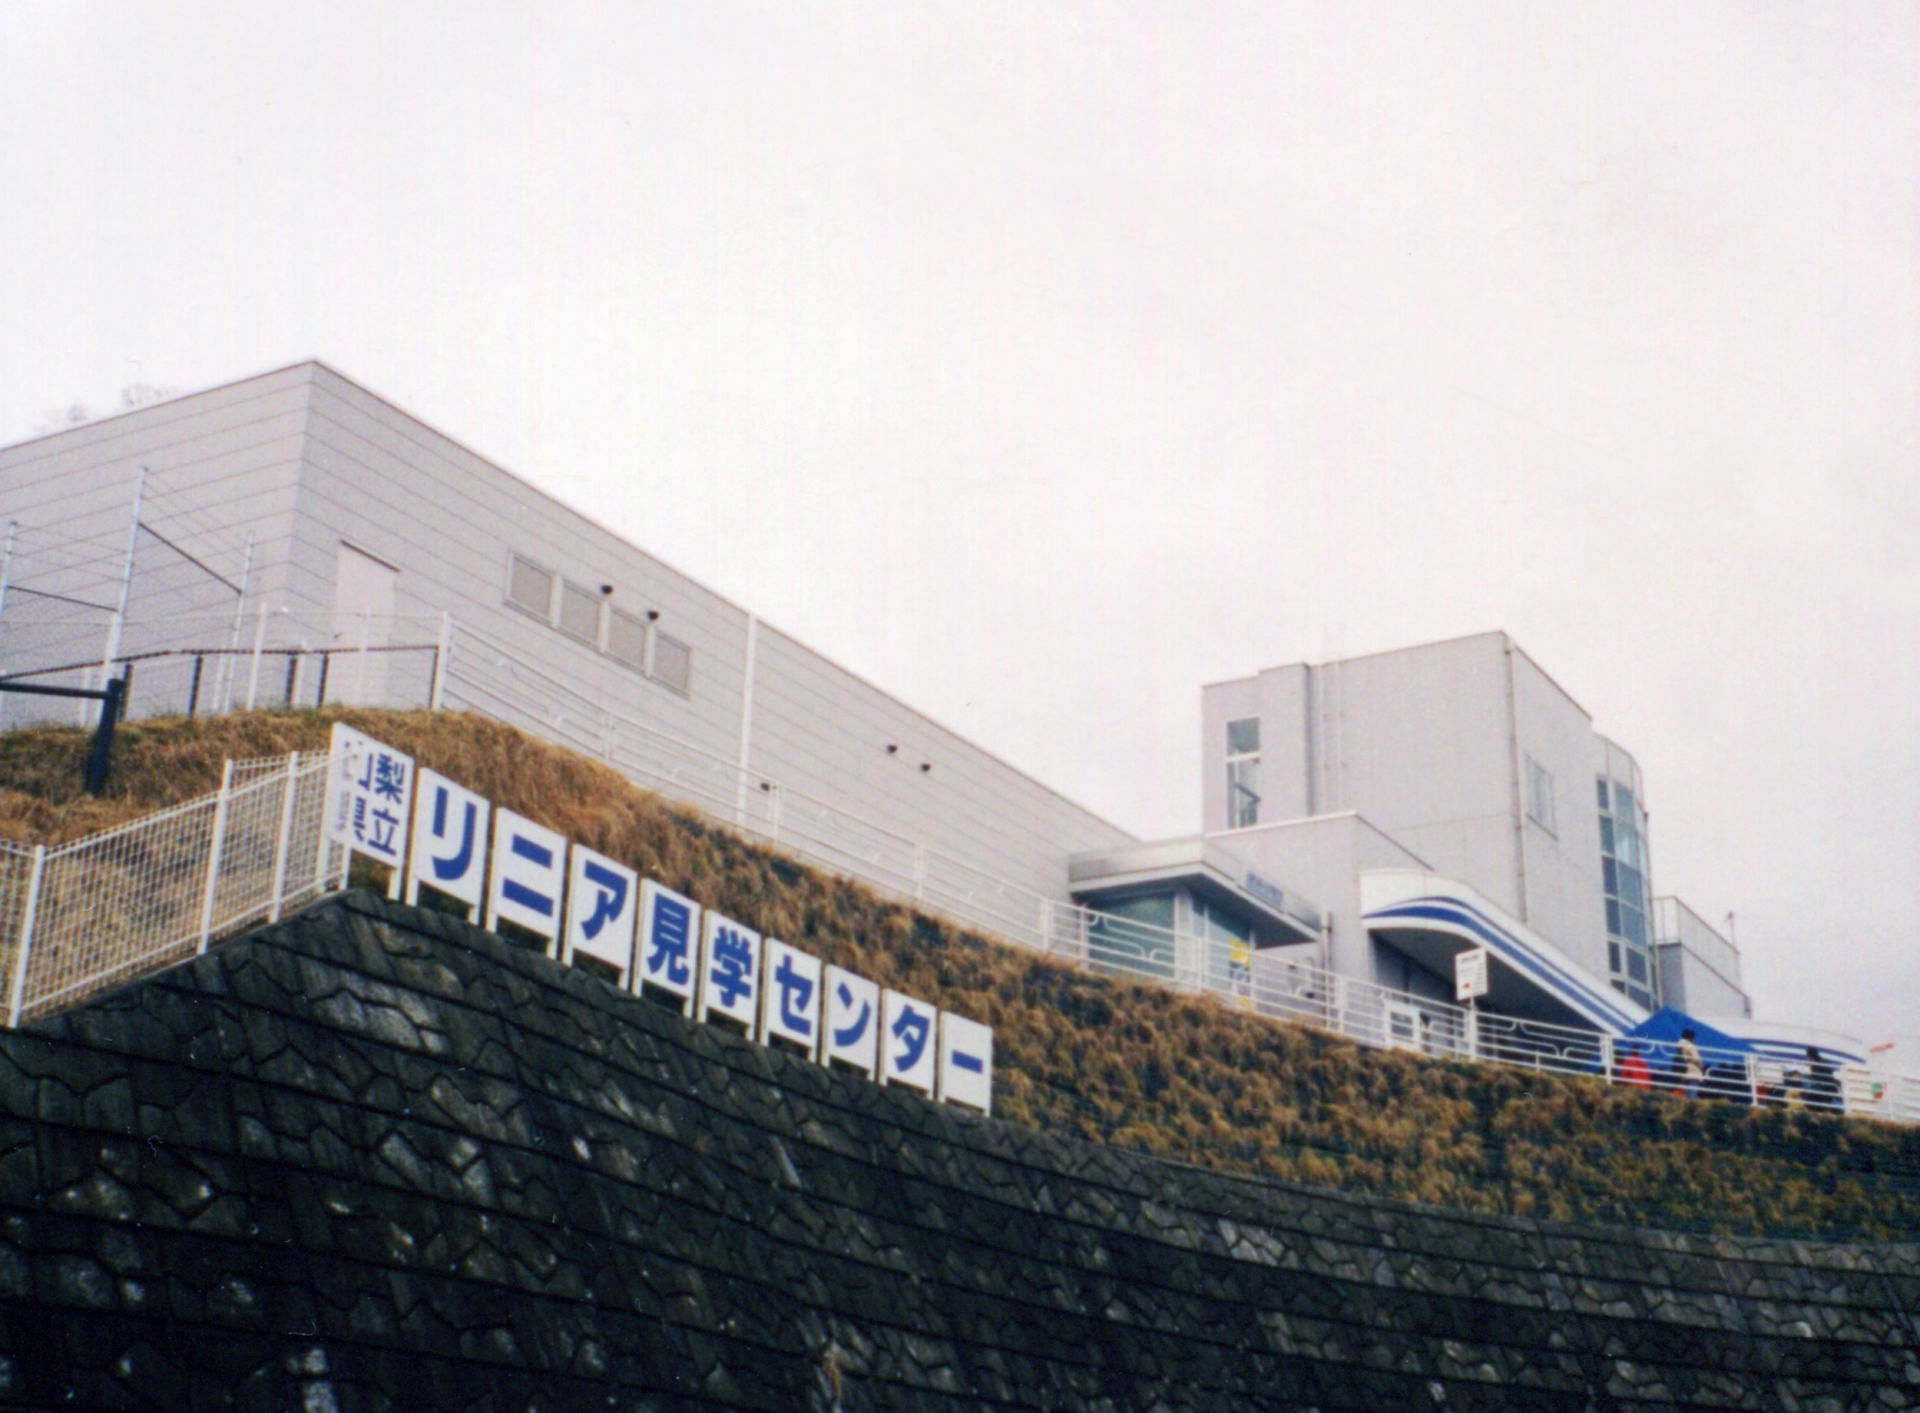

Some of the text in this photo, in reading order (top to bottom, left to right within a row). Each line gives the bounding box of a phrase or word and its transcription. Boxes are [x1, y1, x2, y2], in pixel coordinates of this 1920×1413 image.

[431, 785, 983, 1075] リニア見学センター
